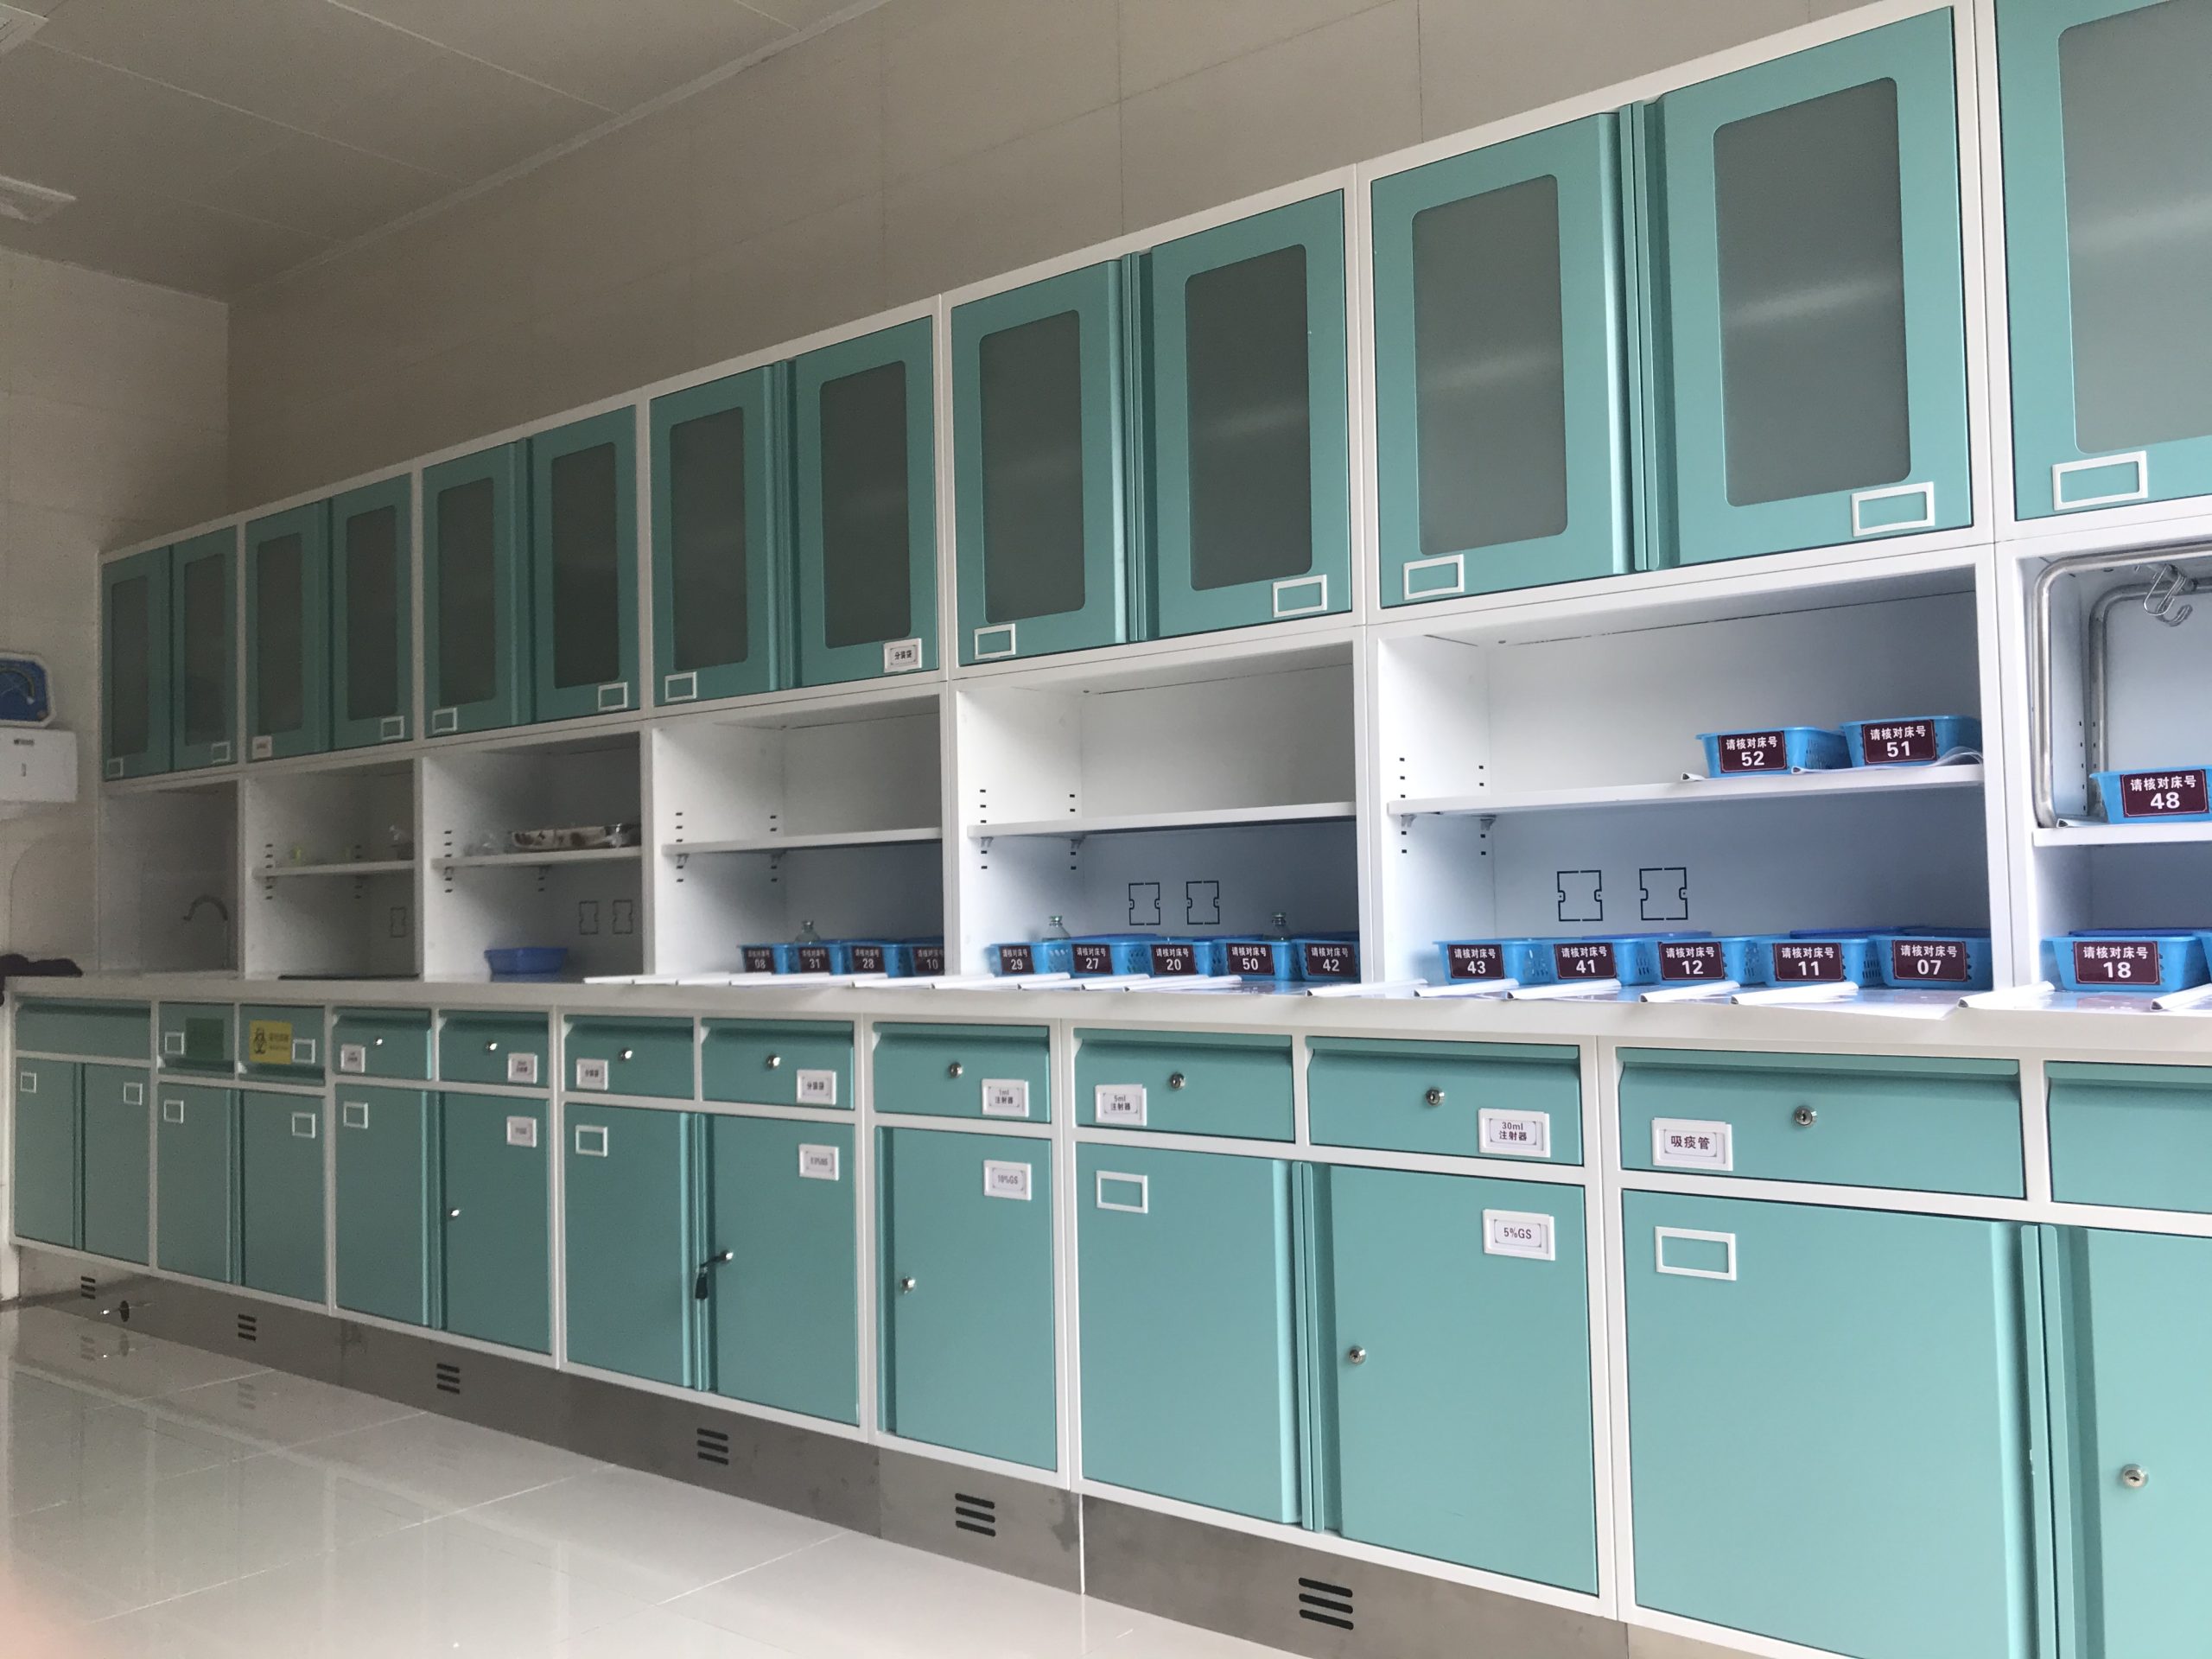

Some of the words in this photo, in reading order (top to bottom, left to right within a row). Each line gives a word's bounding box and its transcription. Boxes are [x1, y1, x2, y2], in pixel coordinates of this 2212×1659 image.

[1870, 725, 1926, 741] 请核对床号
[1726, 736, 1777, 750] 请核对床号
[1886, 741, 1910, 757] 51
[1741, 751, 1764, 766] 52
[2131, 775, 2196, 791] 请核对床号
[2150, 791, 2180, 809] 48
[1077, 947, 1106, 957] 请核对床号
[1231, 946, 1267, 957] 请核对床号
[1312, 947, 1348, 957] 请核对床号
[1453, 947, 1496, 959] 请核对床号
[1560, 946, 1607, 958] 请核对床号
[1666, 947, 1714, 959] 请核对床号
[1782, 947, 1834, 959] 请核对床号
[1901, 945, 1957, 958] 请核对床号
[2083, 946, 2148, 959] 请核对床号
[809, 958, 821, 969] 31
[862, 958, 874, 969] 28
[926, 959, 938, 969] 10
[1011, 959, 1023, 970] 29
[1085, 958, 1099, 969] 27
[1166, 959, 1181, 970] 20
[1243, 957, 1259, 970] 50
[1322, 959, 1339, 971] 42
[1467, 961, 1486, 975] 43
[1576, 960, 1596, 974] 41
[1681, 961, 1704, 975] 12
[1797, 961, 1820, 976] 11
[1916, 959, 1942, 976] 07
[2103, 962, 2132, 979] 18
[1502, 1122, 1523, 1130] 30ml
[1498, 1130, 1528, 1141] 注射器
[1671, 1135, 1711, 1150] 吸痰管
[1503, 1226, 1533, 1240] 5%GS
